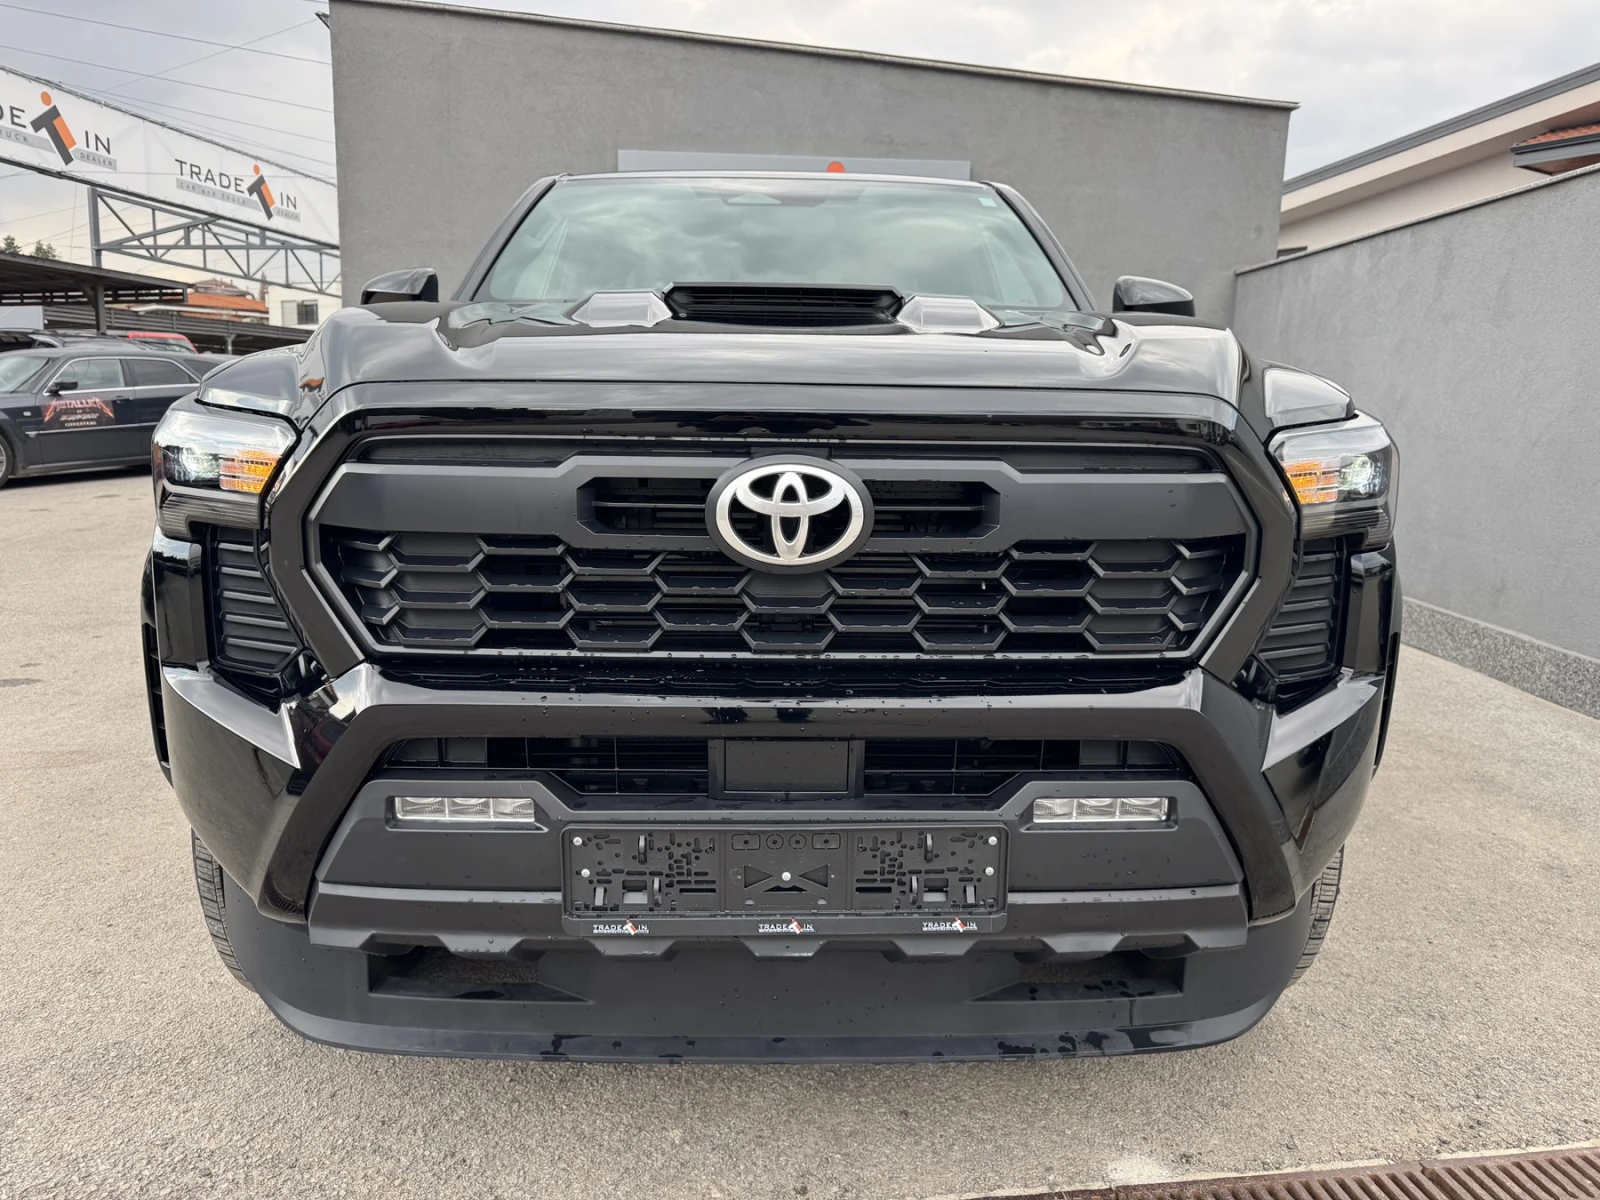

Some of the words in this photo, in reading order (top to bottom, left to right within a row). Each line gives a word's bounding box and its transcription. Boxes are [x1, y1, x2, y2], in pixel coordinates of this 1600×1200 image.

[85, 130, 111, 155] IN
[80, 152, 113, 167] DEALER
[174, 158, 245, 194] TRADE
[280, 191, 297, 210] IN
[179, 182, 196, 191] CAR
[922, 921, 952, 929] TRADE
